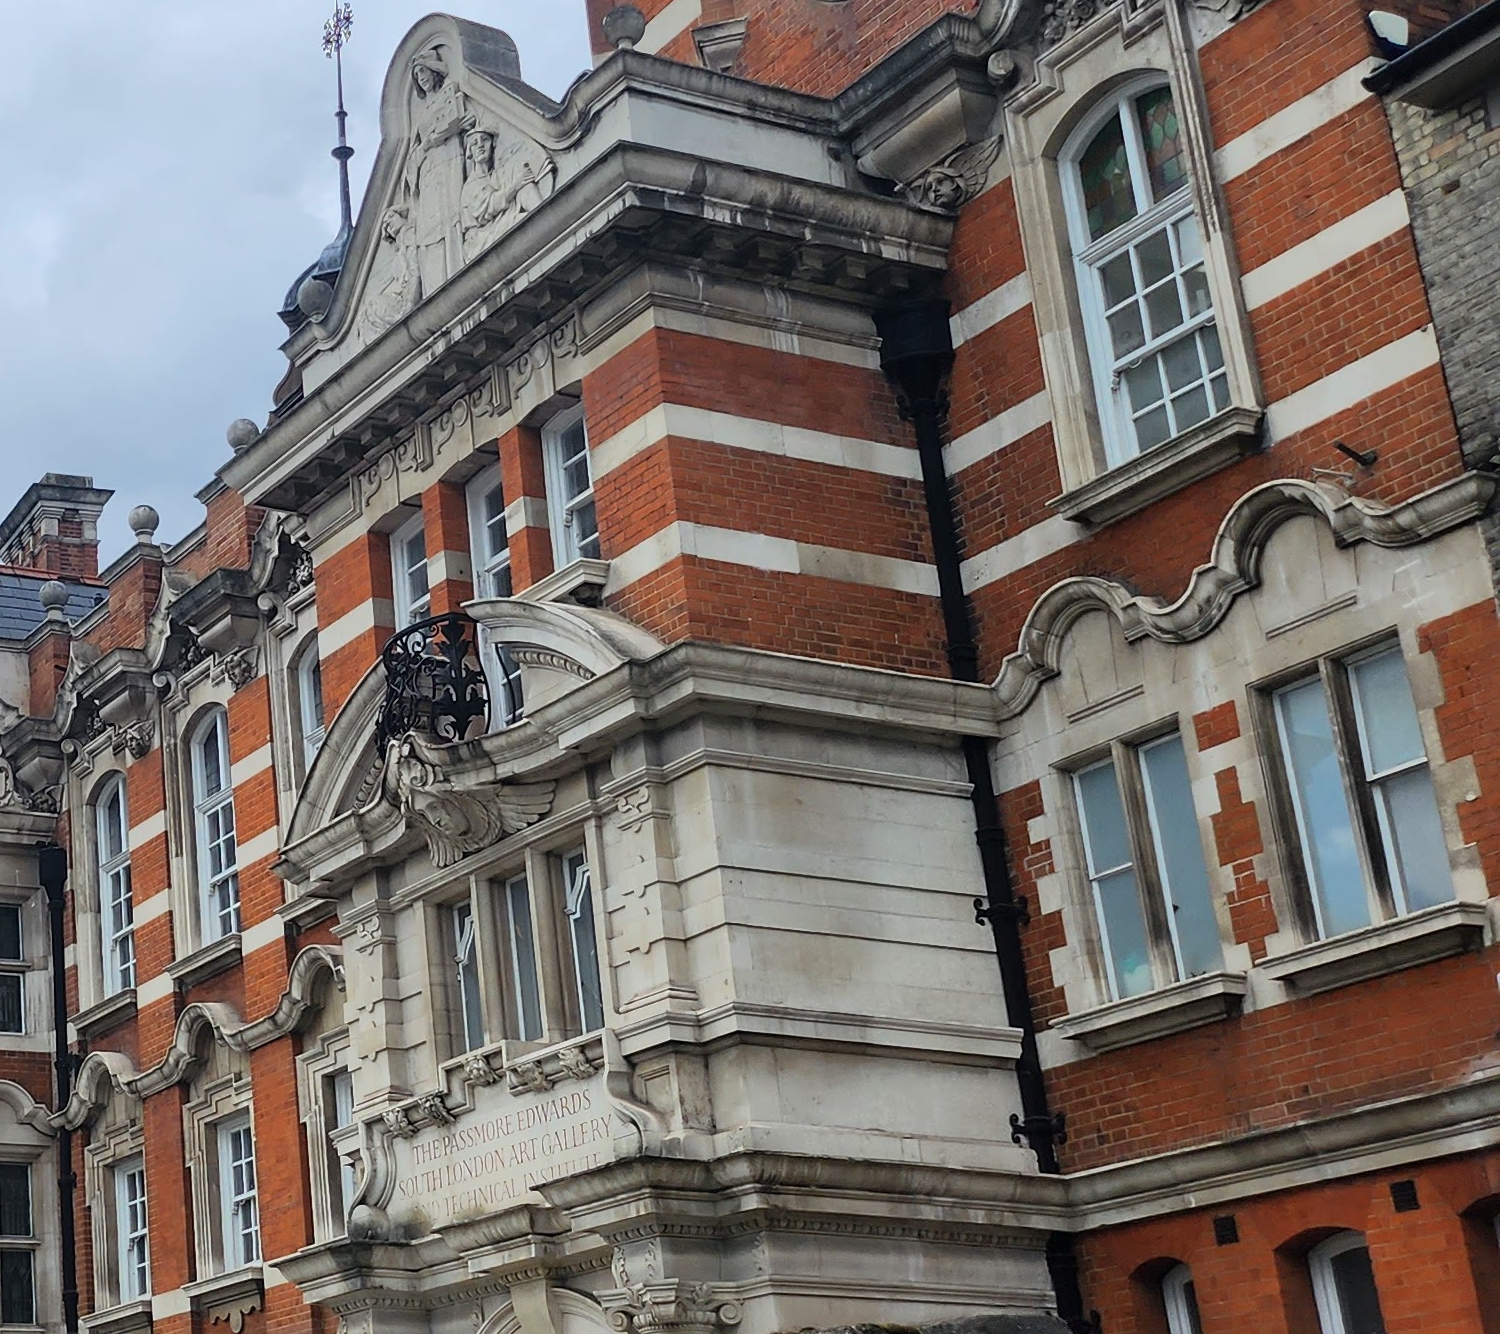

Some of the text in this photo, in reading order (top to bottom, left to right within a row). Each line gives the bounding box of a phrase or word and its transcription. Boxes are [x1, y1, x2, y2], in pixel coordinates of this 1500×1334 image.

[399, 1114, 612, 1200] SOUTH LONDON ART GALLERY
[412, 1089, 592, 1165] THE PASSMORE EDWARDS
[445, 1178, 521, 1216] TECHNICAL
